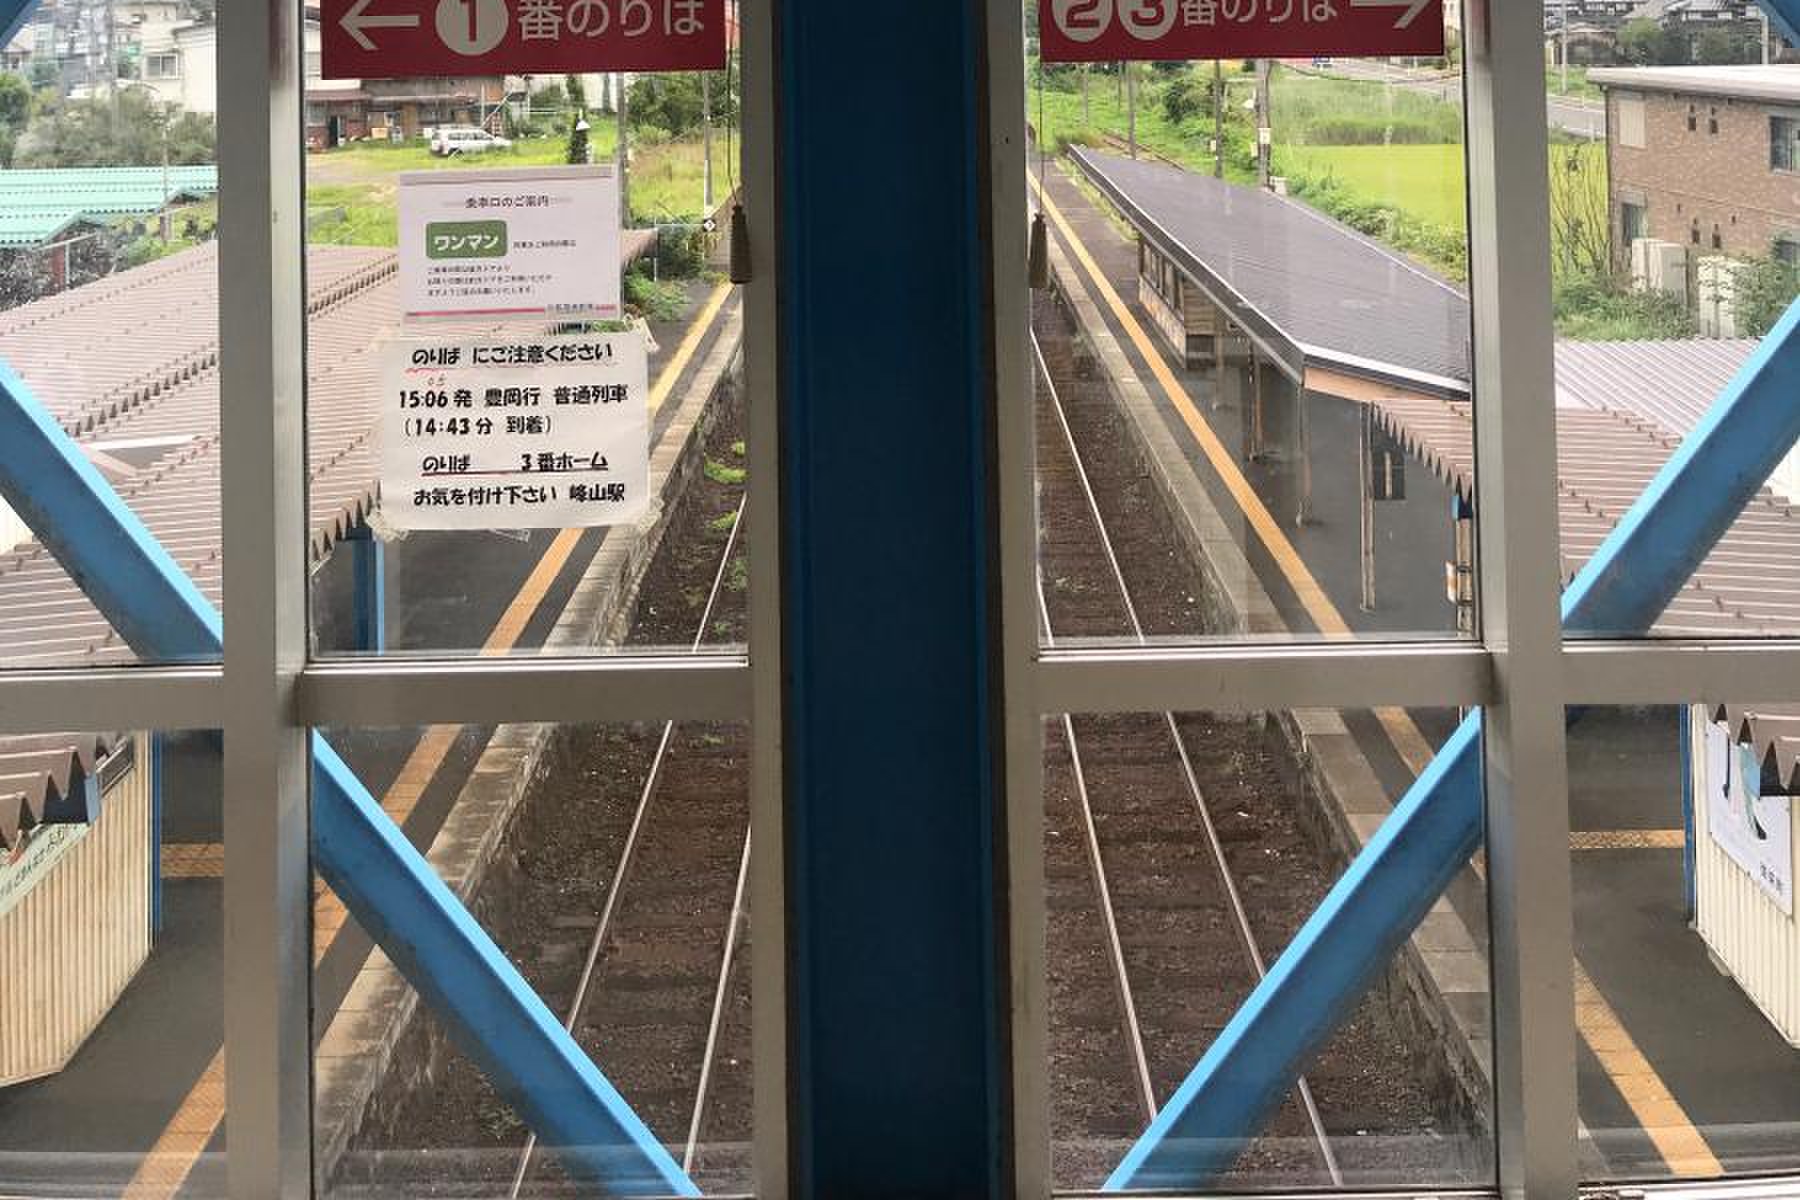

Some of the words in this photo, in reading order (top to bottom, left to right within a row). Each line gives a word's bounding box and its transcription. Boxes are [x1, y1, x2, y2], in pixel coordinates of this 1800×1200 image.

[433, 234, 499, 251] ワンマン
[411, 347, 461, 365] のりば
[472, 343, 612, 365] にご注意ください
[484, 388, 541, 407] 豊岡行
[553, 384, 628, 405] 普通列車
[422, 455, 471, 472] のりば
[414, 485, 557, 507] お気を付け下さい
[569, 483, 625, 503] 峰山駅
